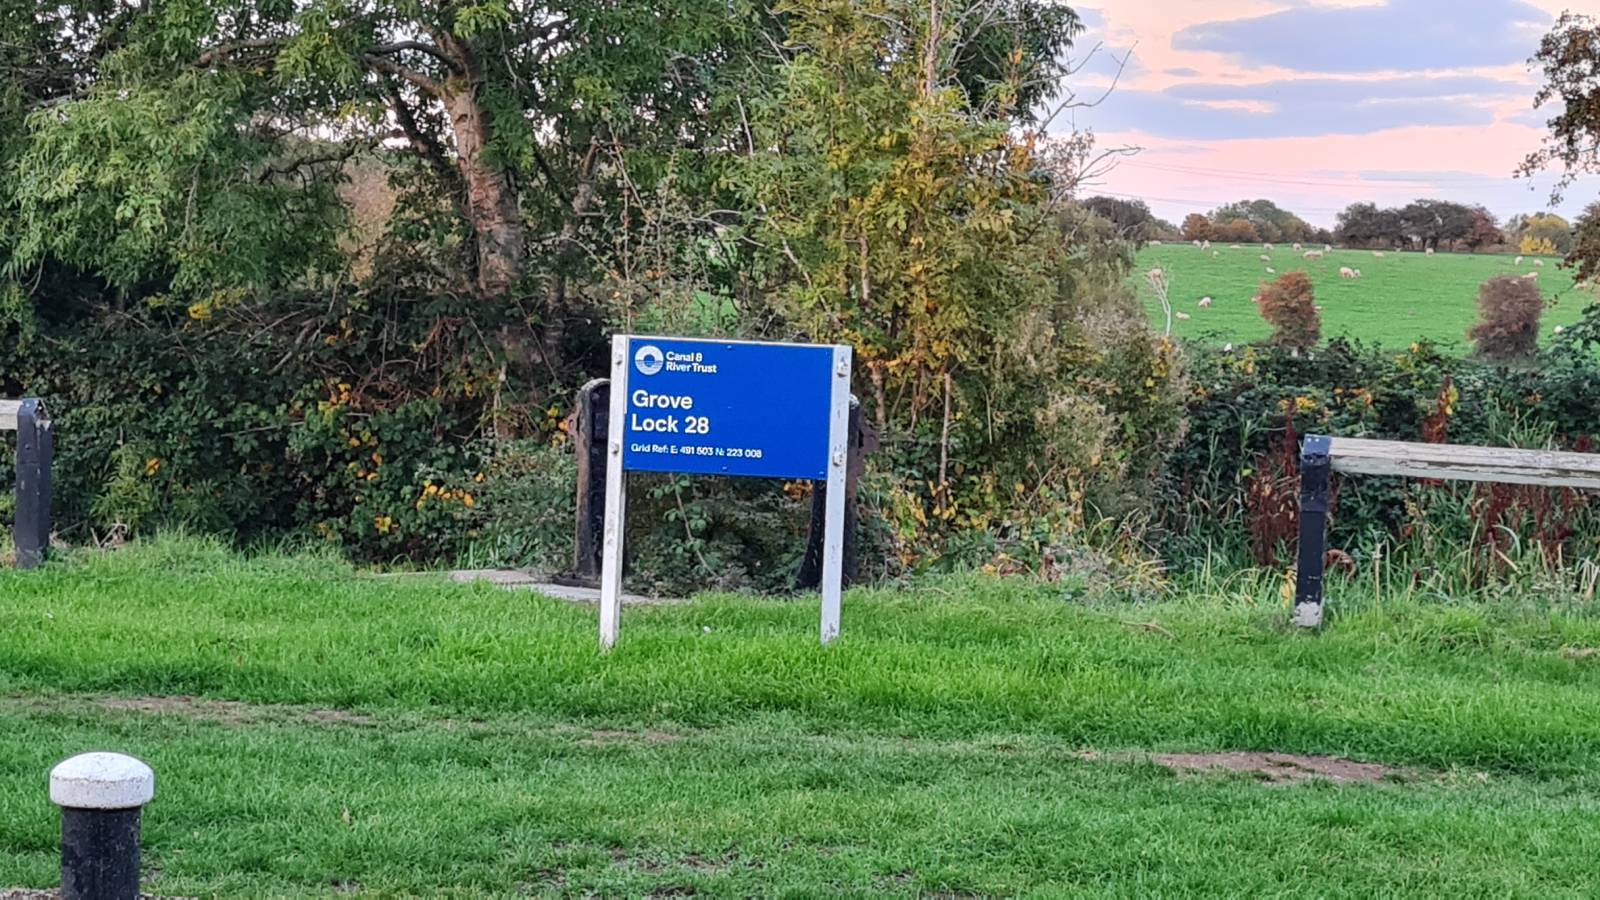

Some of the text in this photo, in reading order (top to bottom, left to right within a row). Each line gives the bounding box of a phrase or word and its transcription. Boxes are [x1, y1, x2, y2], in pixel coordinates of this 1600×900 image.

[665, 351, 694, 362] Canal
[665, 362, 718, 374] River Trust
[632, 389, 692, 410] Grove
[631, 414, 710, 434] Lock 28
[630, 444, 650, 453] Grid
[652, 444, 669, 454] Ref:
[679, 446, 695, 455] 491
[727, 448, 744, 457] 223
